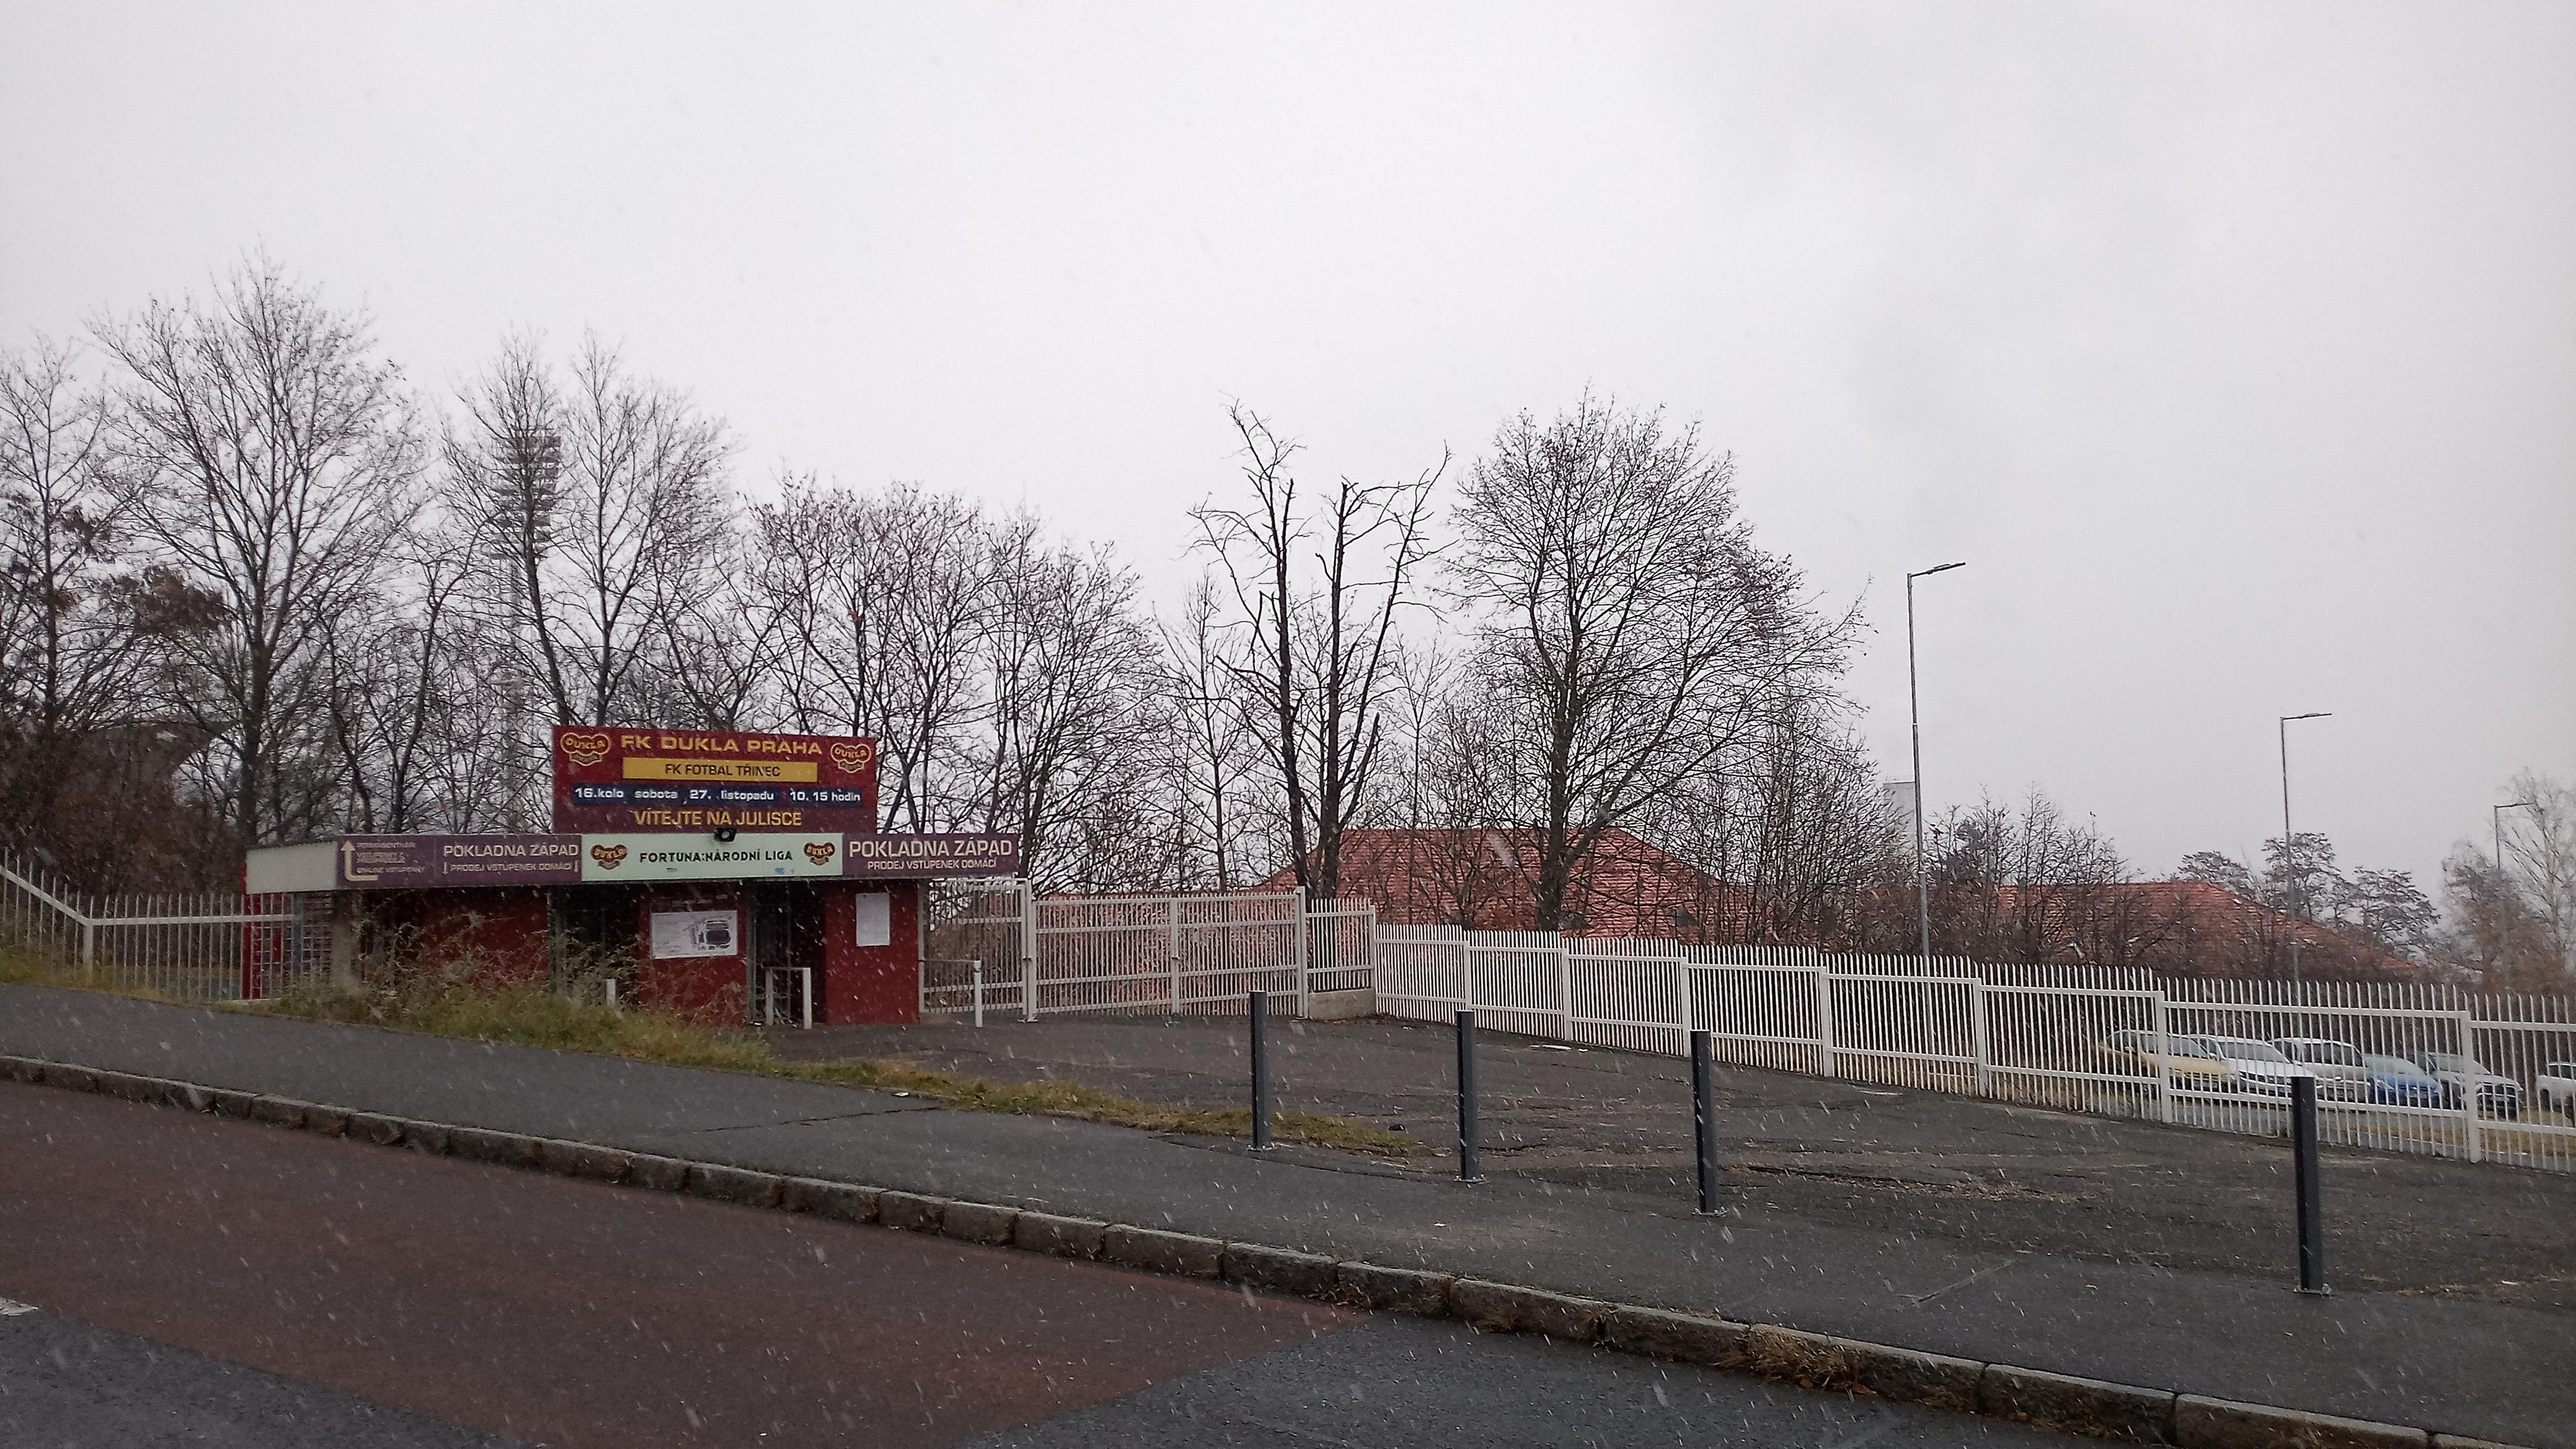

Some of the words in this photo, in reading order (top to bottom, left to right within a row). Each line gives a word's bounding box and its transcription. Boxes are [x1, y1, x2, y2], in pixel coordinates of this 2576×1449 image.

[621, 735, 652, 749] FK
[661, 736, 740, 752] DUKLA
[746, 739, 822, 755] PRAHA
[665, 764, 682, 775] FK
[685, 764, 733, 776] FOTBAL
[735, 763, 781, 777] TŘINEC
[634, 788, 678, 799] sobota
[689, 790, 711, 800] 27.
[721, 790, 774, 802] listopadu
[813, 791, 828, 801] 15
[831, 791, 861, 802] hodin
[633, 808, 702, 826] VÍTEJTE
[706, 810, 733, 826] NA
[735, 810, 802, 826] JULISCE
[443, 845, 526, 857] POKLADNA
[529, 842, 579, 857] ZÁPAD
[849, 840, 950, 858] POKLADNA
[954, 837, 1012, 857] ZÁPAD
[765, 850, 793, 861] LIGA
[451, 864, 486, 872] PRODEJ
[487, 863, 537, 871] VSTUPENEK
[867, 861, 904, 870] PRODEJ
[907, 860, 960, 869] VSTUPENEK
[961, 857, 998, 869] DOMÁCÍ
